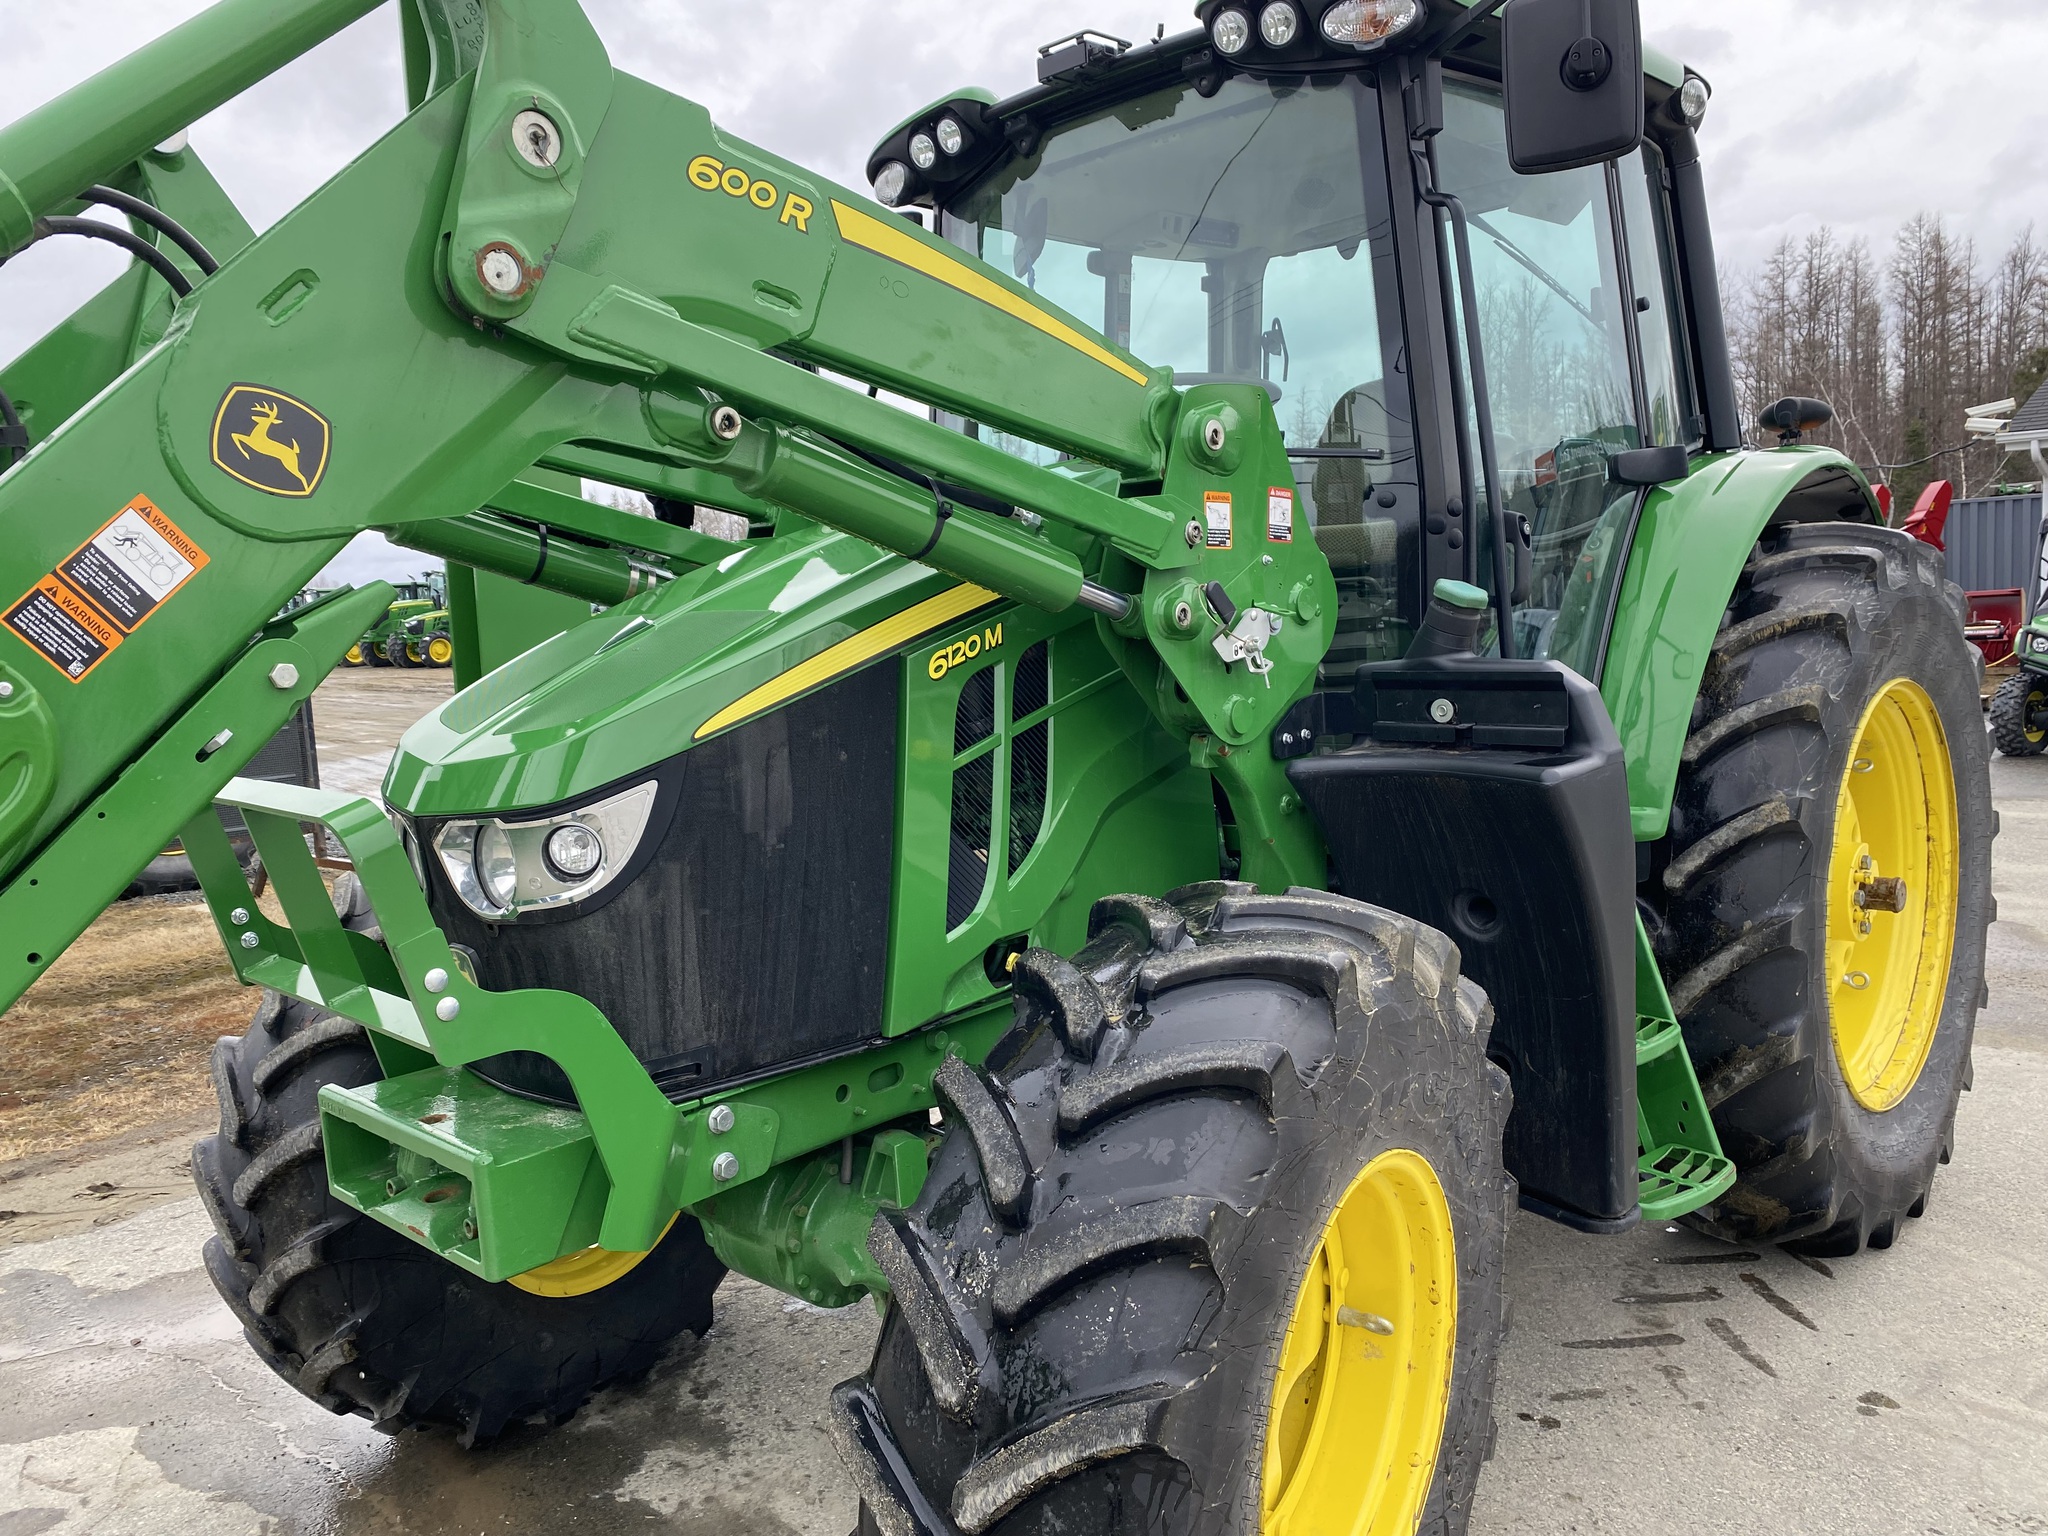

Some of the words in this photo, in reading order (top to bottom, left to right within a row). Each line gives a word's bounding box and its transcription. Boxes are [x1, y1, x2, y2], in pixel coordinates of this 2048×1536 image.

[686, 154, 778, 210] 600
[778, 190, 814, 235] R
[1275, 489, 1291, 498] DANGER
[152, 515, 198, 560] WARNING
[75, 565, 89, 578] Lower
[88, 577, 103, 590] loader
[106, 594, 122, 607] ground
[121, 607, 133, 617] when
[80, 562, 96, 576] service
[95, 576, 108, 587] under
[110, 590, 124, 602] raised
[94, 553, 107, 564] avoid
[106, 563, 119, 575] injury
[118, 573, 128, 583] from
[127, 582, 140, 596] falling
[98, 571, 108, 580] walk
[112, 584, 129, 600] perform
[18, 613, 29, 623] from
[28, 622, 42, 634] loader
[41, 633, 58, 649] causing
[57, 646, 73, 660] serious
[22, 610, 35, 621] result
[38, 624, 62, 643] attachment
[61, 642, 82, 661] detaching
[26, 605, 41, 619] Failure
[46, 622, 61, 635] engage
[60, 634, 77, 648] retainer
[76, 648, 89, 658] could
[26, 628, 39, 639] injury
[34, 600, 53, 618] engaging
[52, 616, 76, 636] attachment
[45, 602, 57, 611] NOT
[55, 610, 71, 625] operate
[70, 623, 84, 635] loader
[83, 634, 99, 648] without
[62, 596, 110, 641] WARNING
[928, 634, 982, 681] 6120
[984, 621, 1003, 651] M
